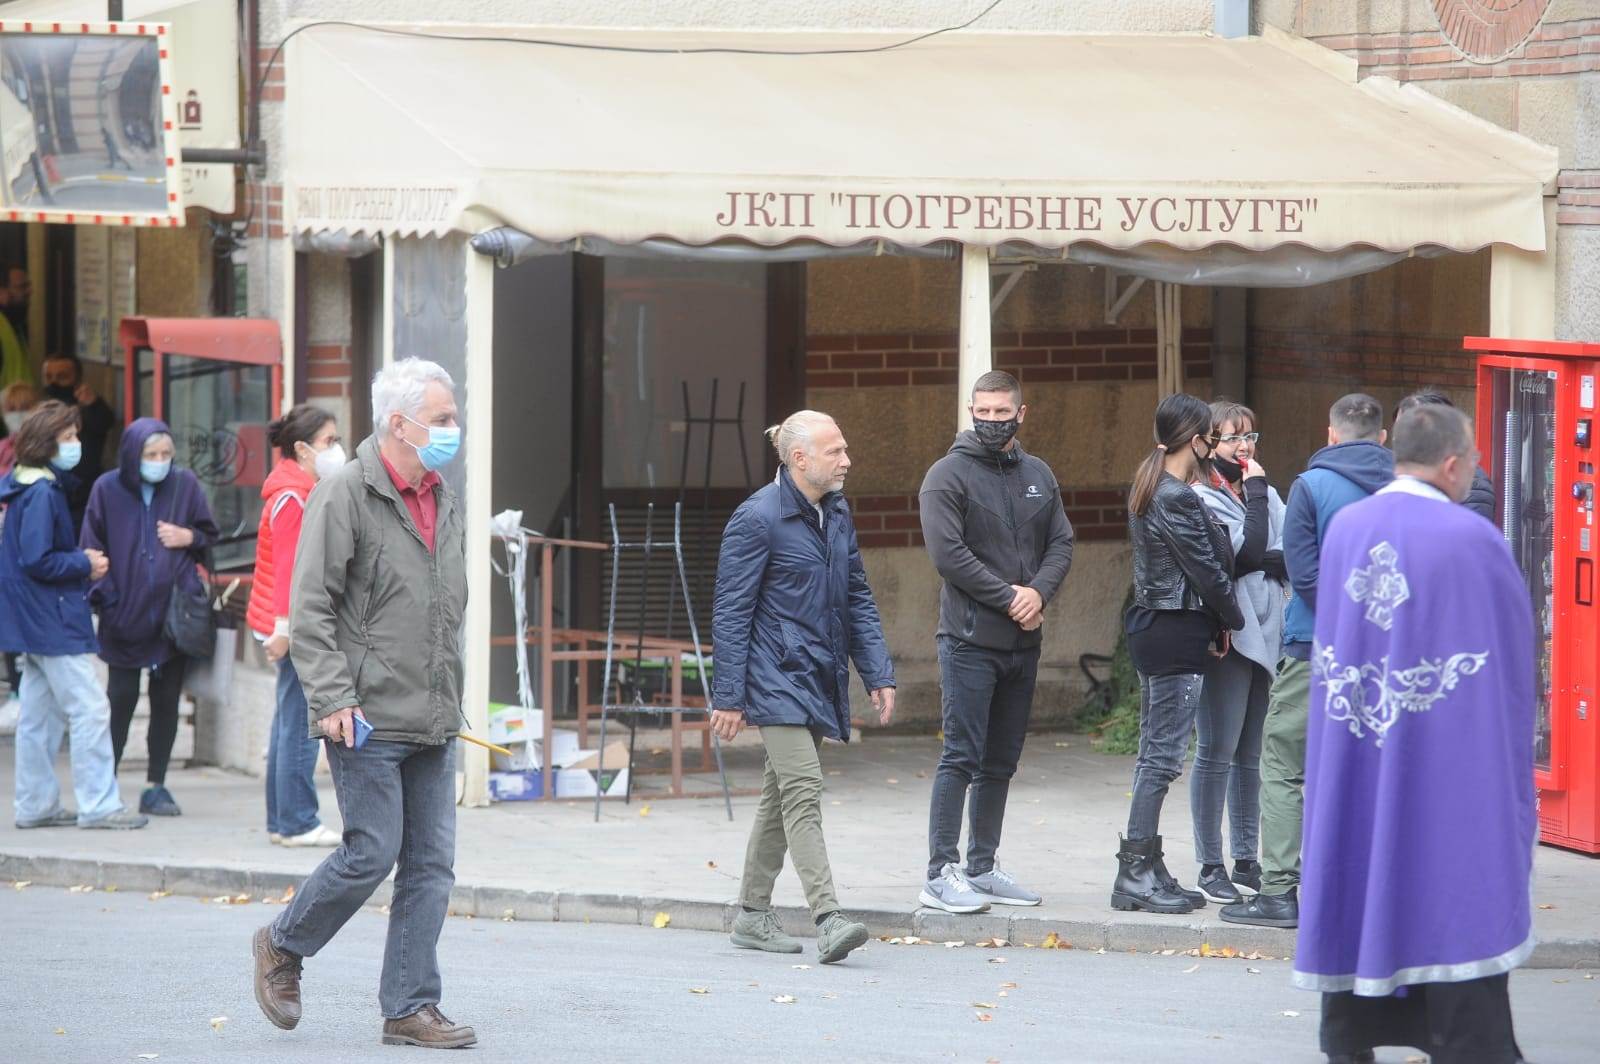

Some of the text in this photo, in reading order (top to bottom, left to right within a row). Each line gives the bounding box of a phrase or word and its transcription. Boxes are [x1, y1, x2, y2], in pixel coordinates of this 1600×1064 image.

[715, 192, 1318, 233] ЈКП "ПОГРЕБНЕ УСЛУГЕ"
